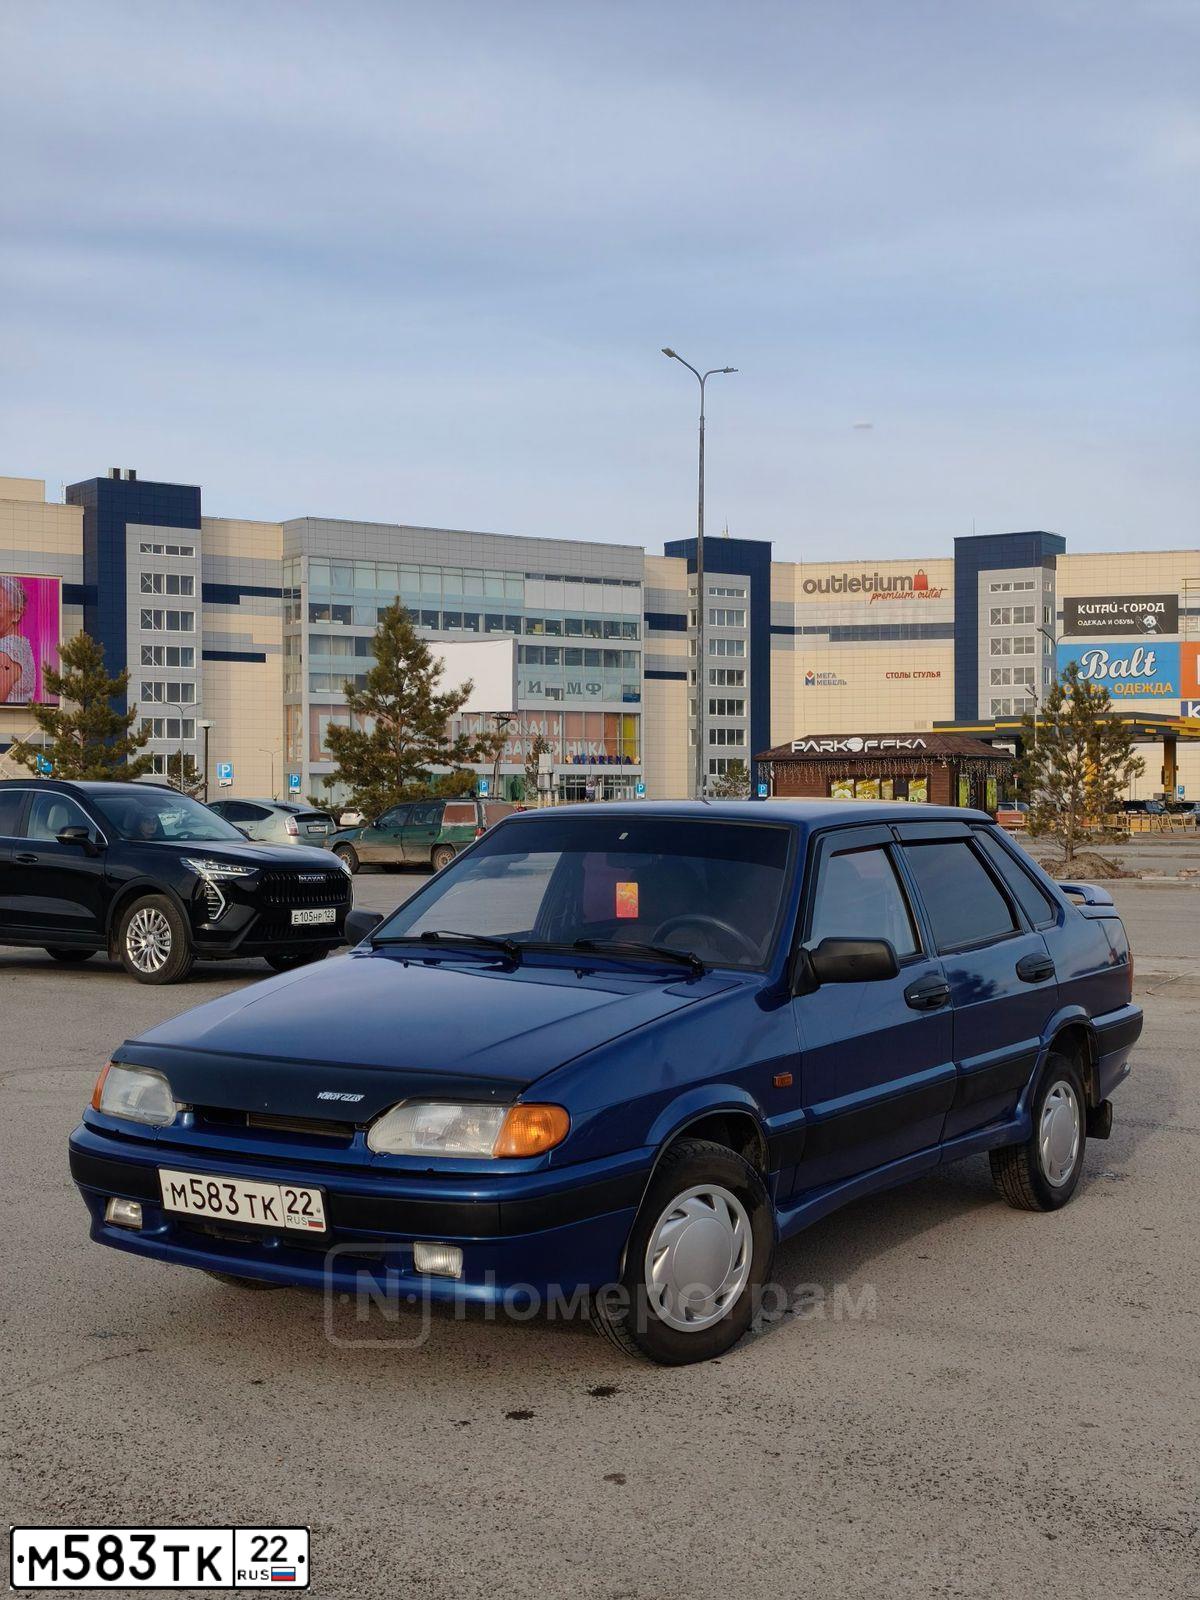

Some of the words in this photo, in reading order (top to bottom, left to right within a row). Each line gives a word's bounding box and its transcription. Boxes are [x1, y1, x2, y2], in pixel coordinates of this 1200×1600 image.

[803, 573, 913, 594] outletium
[869, 591, 914, 604] premium
[1077, 602, 1165, 614] КИТАЙ-ГОРОД
[1077, 647, 1157, 680] Balt
[885, 671, 911, 679] СТОЛЫ
[1114, 682, 1173, 695] ОДЕЖДА
[791, 737, 928, 753] PARKOFFKA
[285, 1190, 314, 1216] 22
[286, 1216, 307, 1226] RUS
